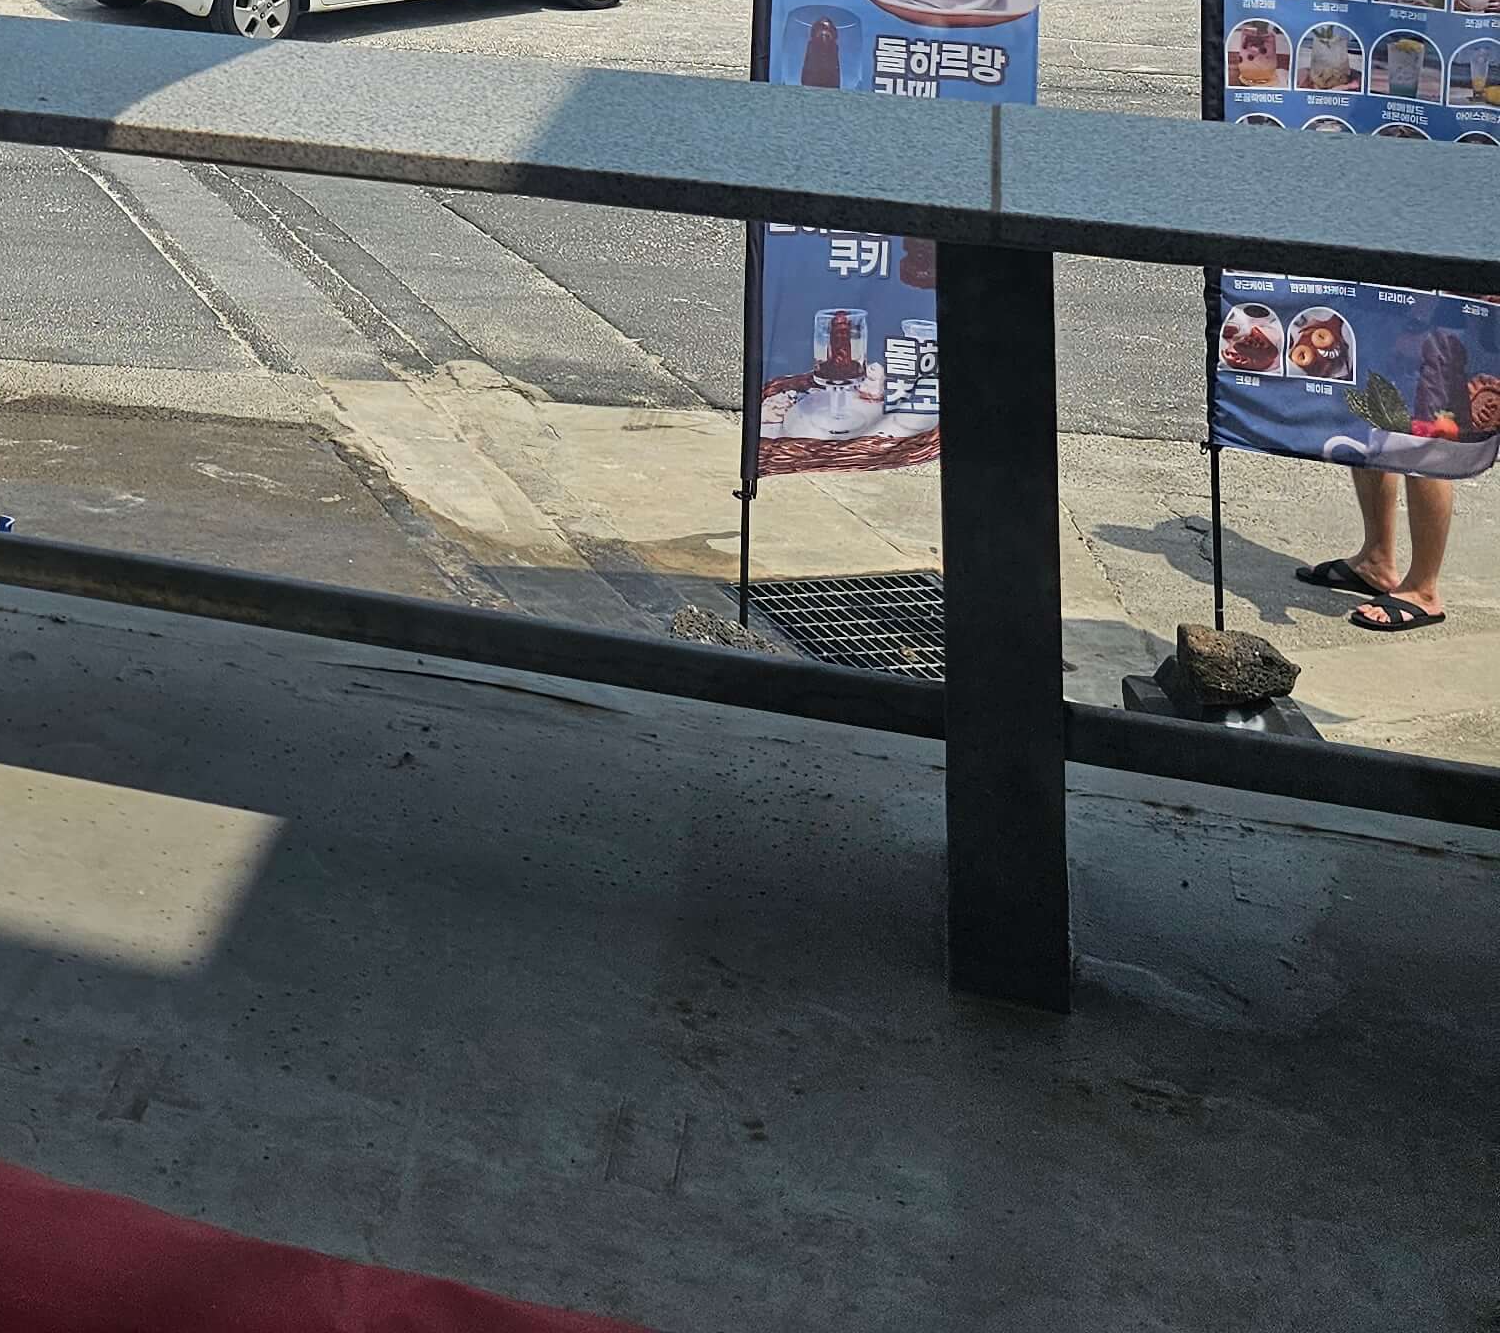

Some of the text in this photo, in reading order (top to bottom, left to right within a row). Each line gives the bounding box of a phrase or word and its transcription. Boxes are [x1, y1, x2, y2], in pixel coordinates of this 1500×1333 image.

[875, 37, 1006, 83] 돌하르방
[828, 239, 890, 277] 쿠키
[1378, 291, 1417, 305] 티라미수
